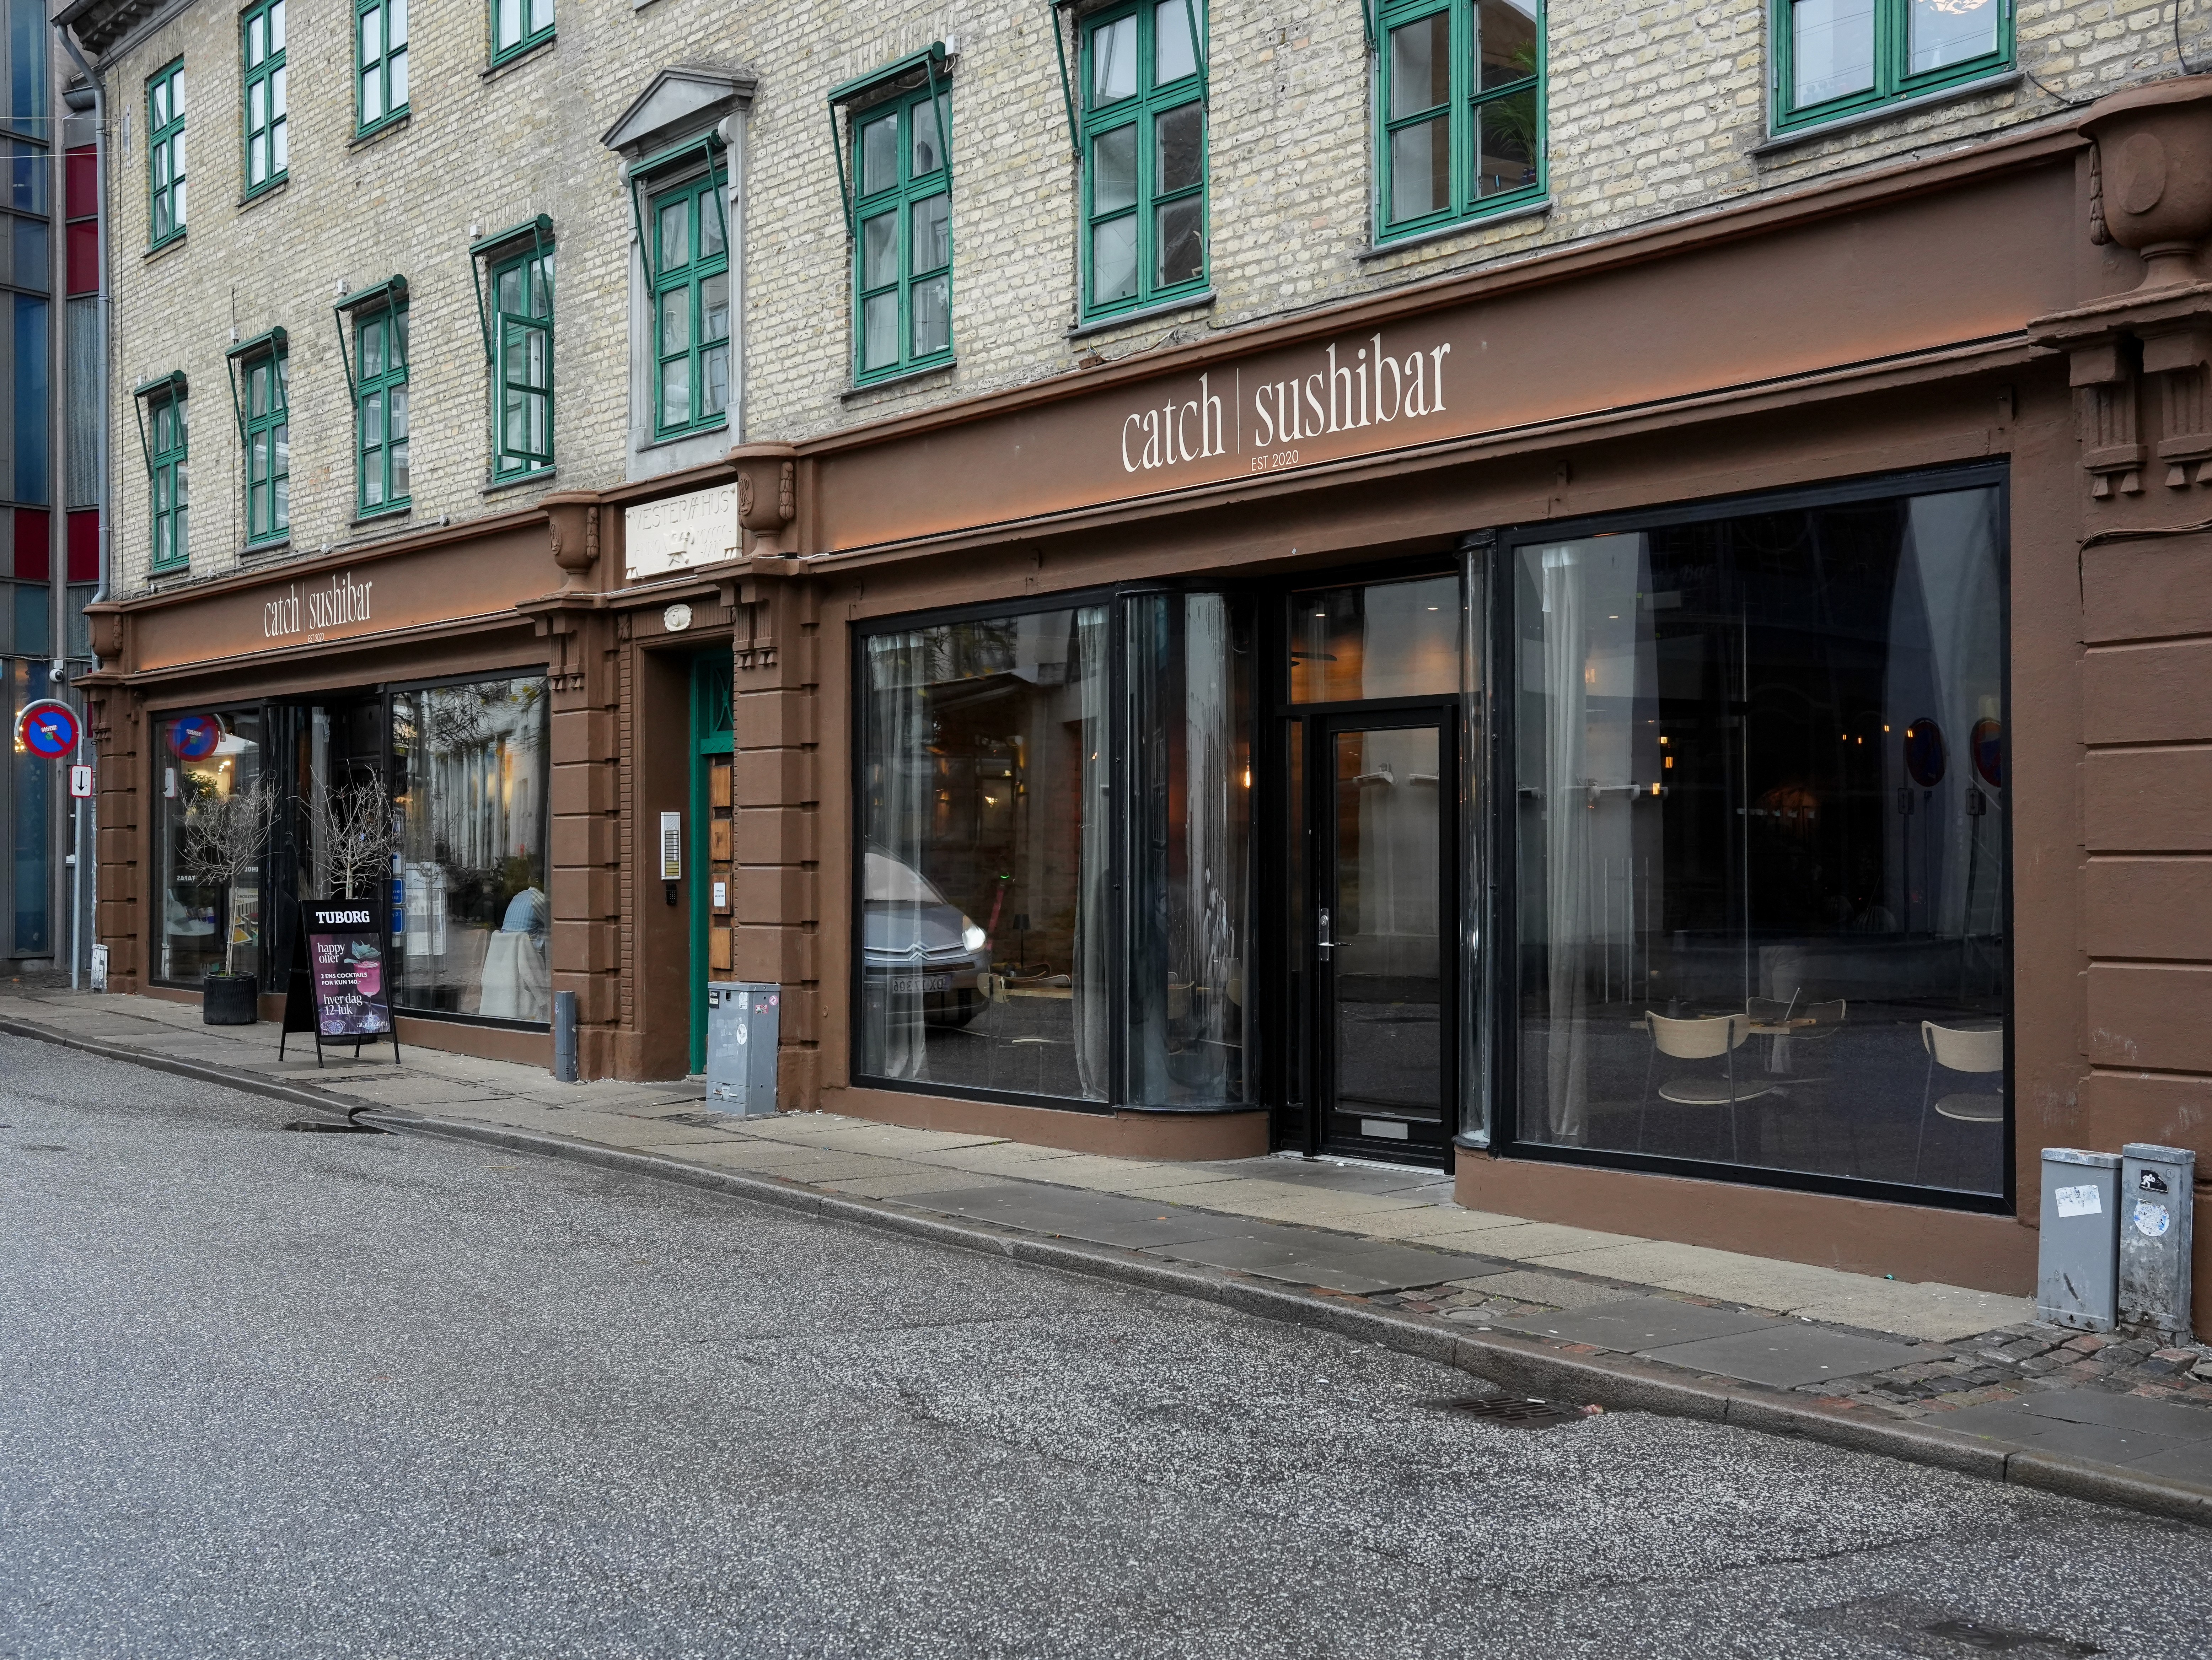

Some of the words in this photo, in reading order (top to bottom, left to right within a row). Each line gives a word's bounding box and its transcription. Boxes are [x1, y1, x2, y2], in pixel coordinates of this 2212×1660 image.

[1122, 372, 1226, 472] catch
[1255, 333, 1451, 447] sushibar
[1251, 456, 1269, 471] EST
[1272, 450, 1299, 469] 2020
[634, 540, 660, 558] ANNO
[264, 583, 300, 637] catch
[309, 571, 372, 629] sushibar
[315, 632, 324, 641] 2020
[316, 910, 370, 924] TUBORG
[317, 942, 345, 955] happy
[319, 953, 339, 964] offer
[323, 994, 344, 1004] hver
[345, 993, 363, 1006] dag
[324, 1004, 353, 1015] 12-luk
